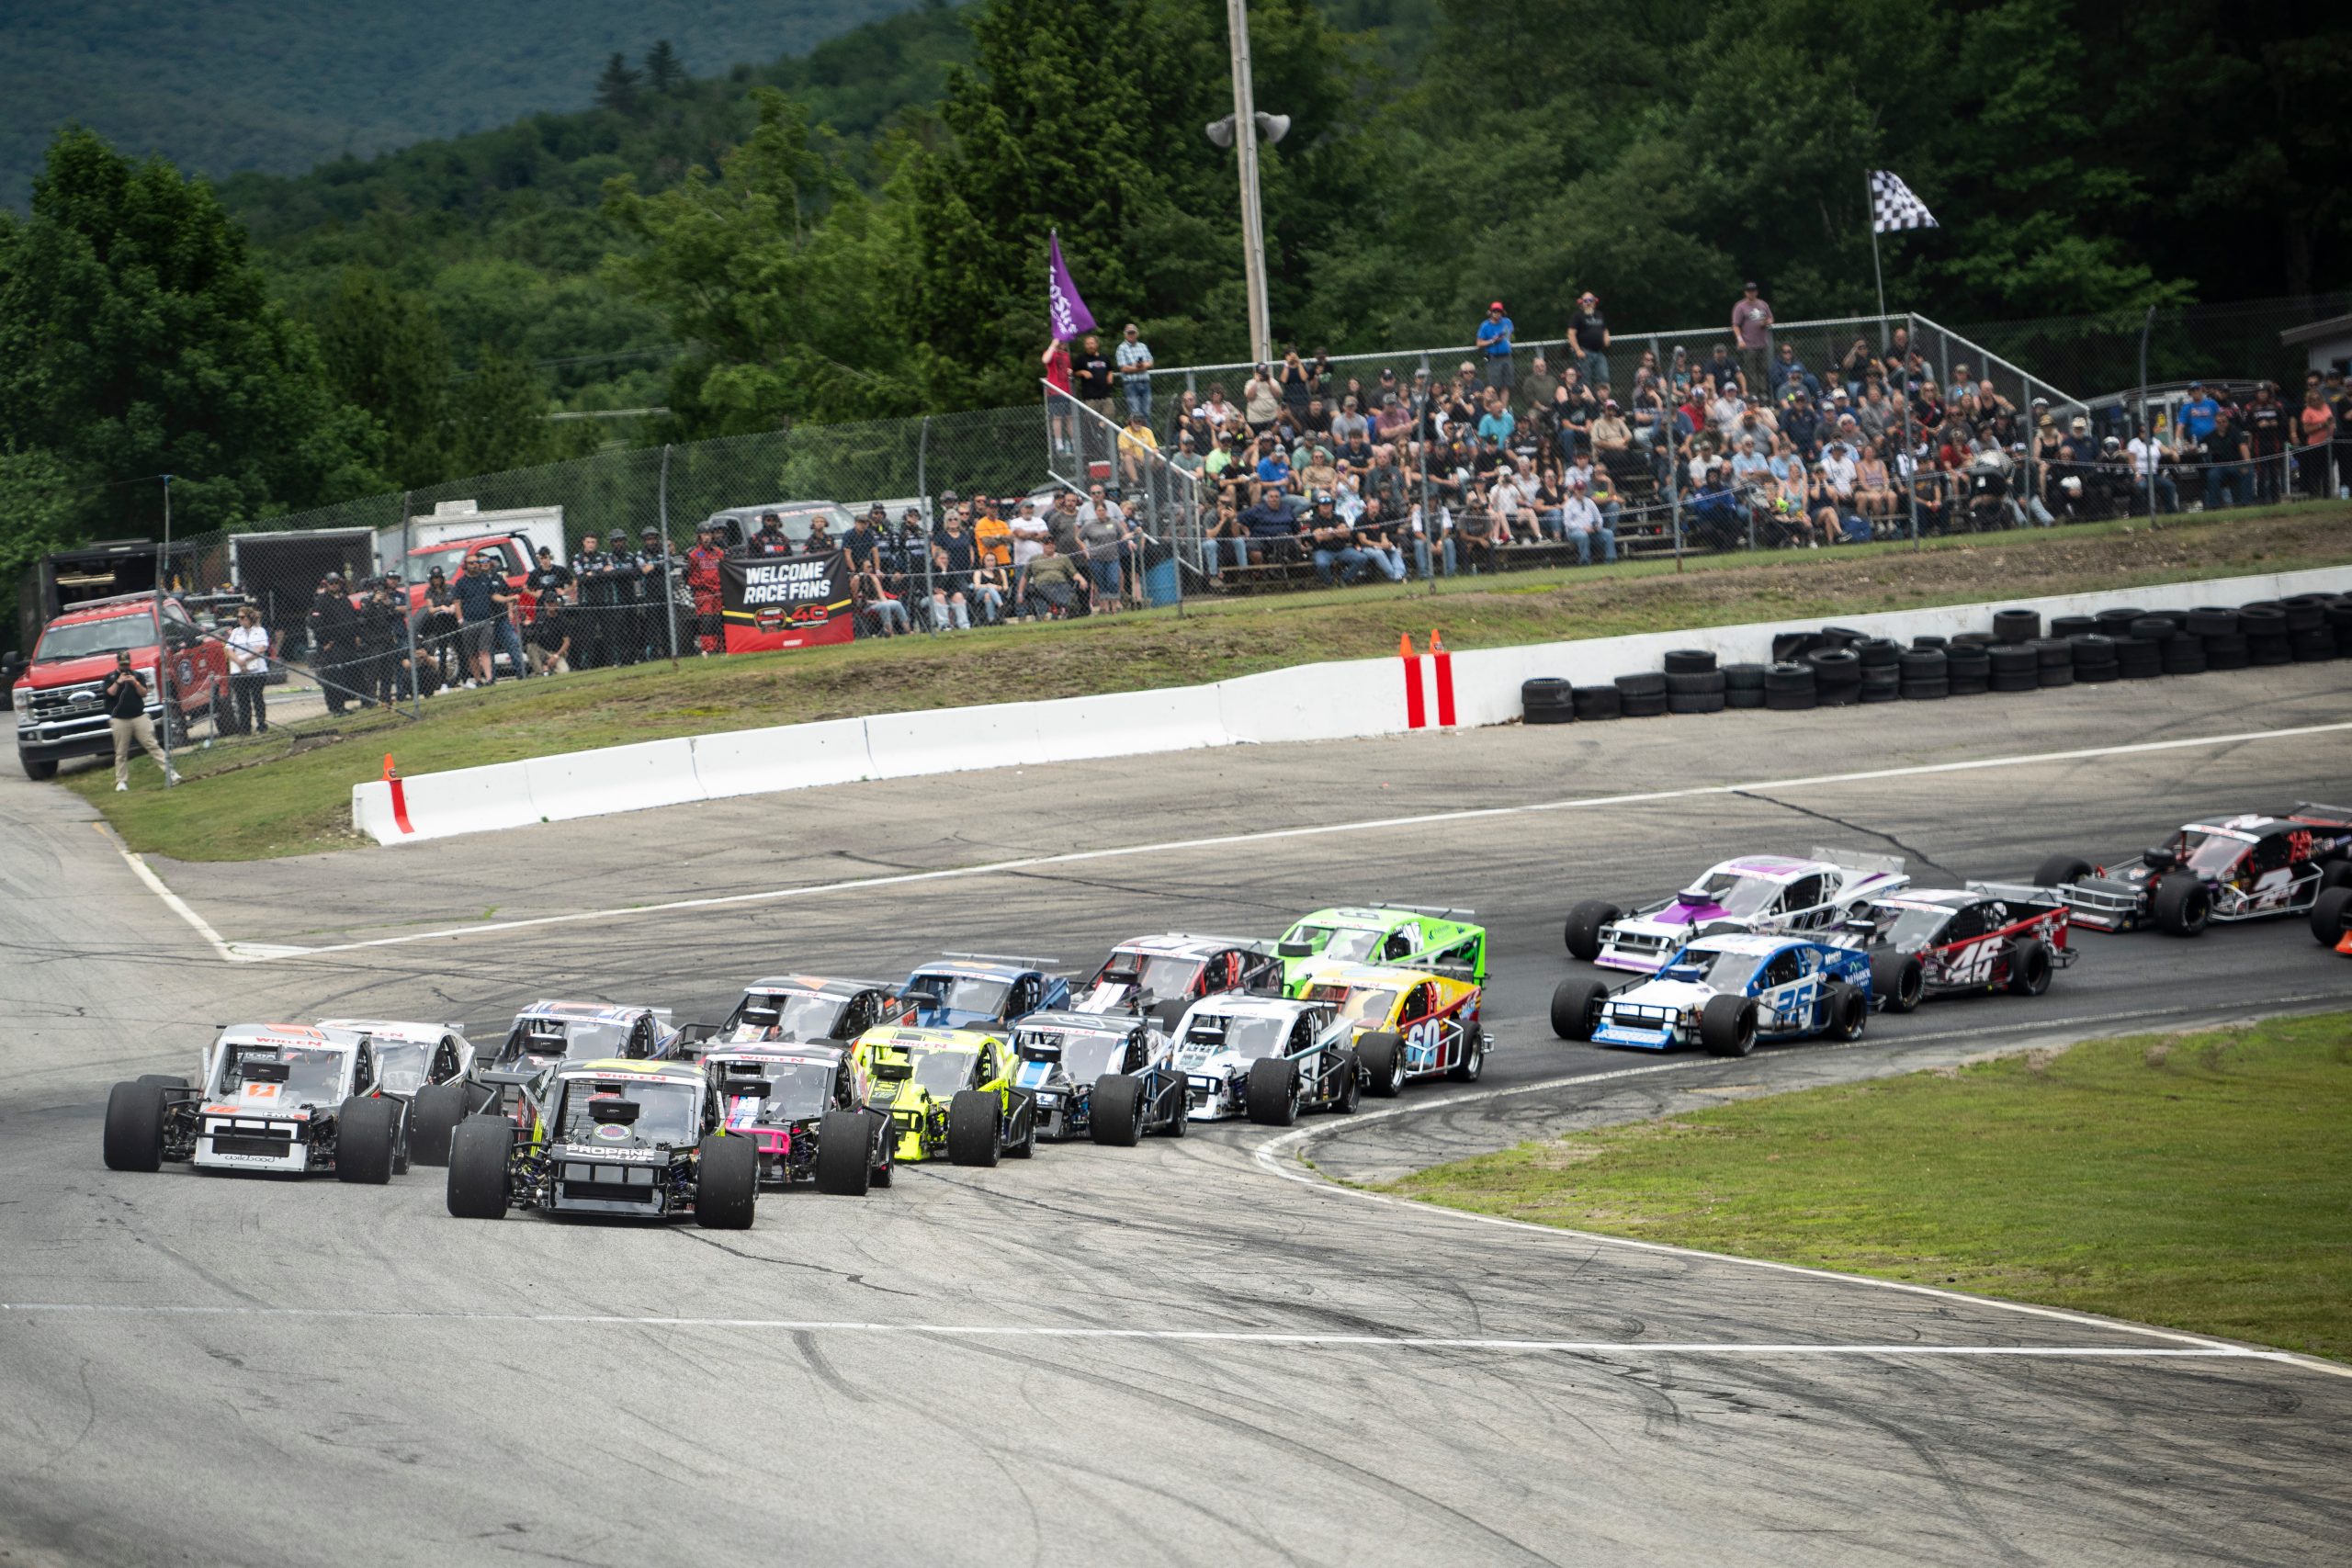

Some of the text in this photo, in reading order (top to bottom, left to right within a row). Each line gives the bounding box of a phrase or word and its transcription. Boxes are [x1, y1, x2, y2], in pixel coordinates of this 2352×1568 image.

[745, 560, 825, 585] WELCOME
[742, 579, 831, 604] RACE FANS
[791, 604, 828, 622] 40
[255, 1036, 322, 1047] WHELEN
[889, 1039, 948, 1050] WHELEN
[1407, 1016, 1441, 1064] 60
[740, 1055, 806, 1064] WHELEN
[594, 1072, 667, 1082] WHELEN
[566, 1144, 655, 1156] PROPANE
